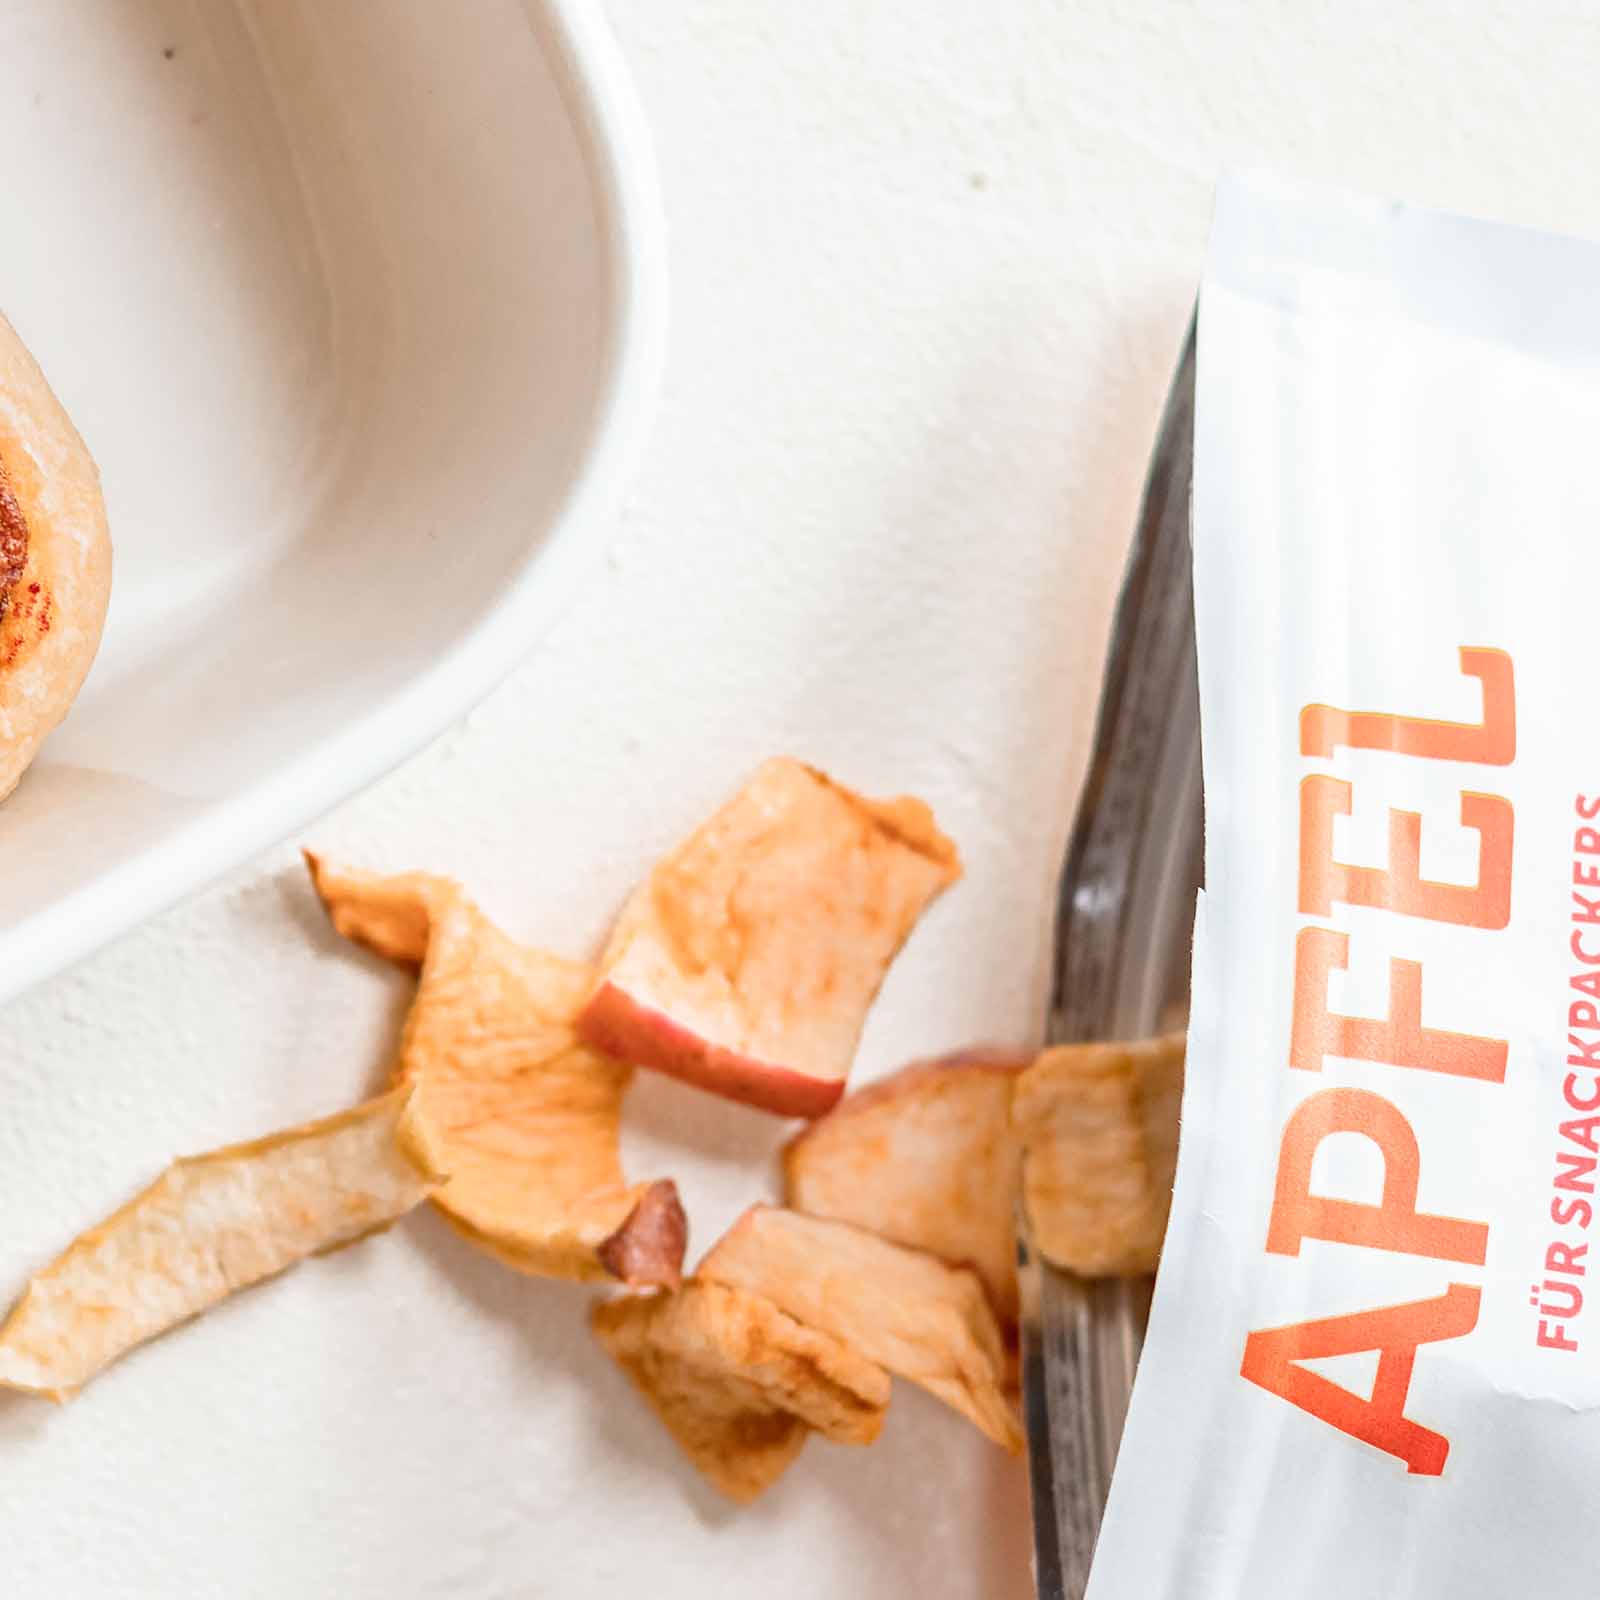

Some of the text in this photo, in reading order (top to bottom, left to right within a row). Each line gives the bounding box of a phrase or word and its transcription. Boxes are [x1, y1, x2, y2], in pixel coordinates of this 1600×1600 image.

[1241, 646, 1516, 1477] APFEL
[1529, 793, 1600, 1352] FÜR SNACKPACKERS
